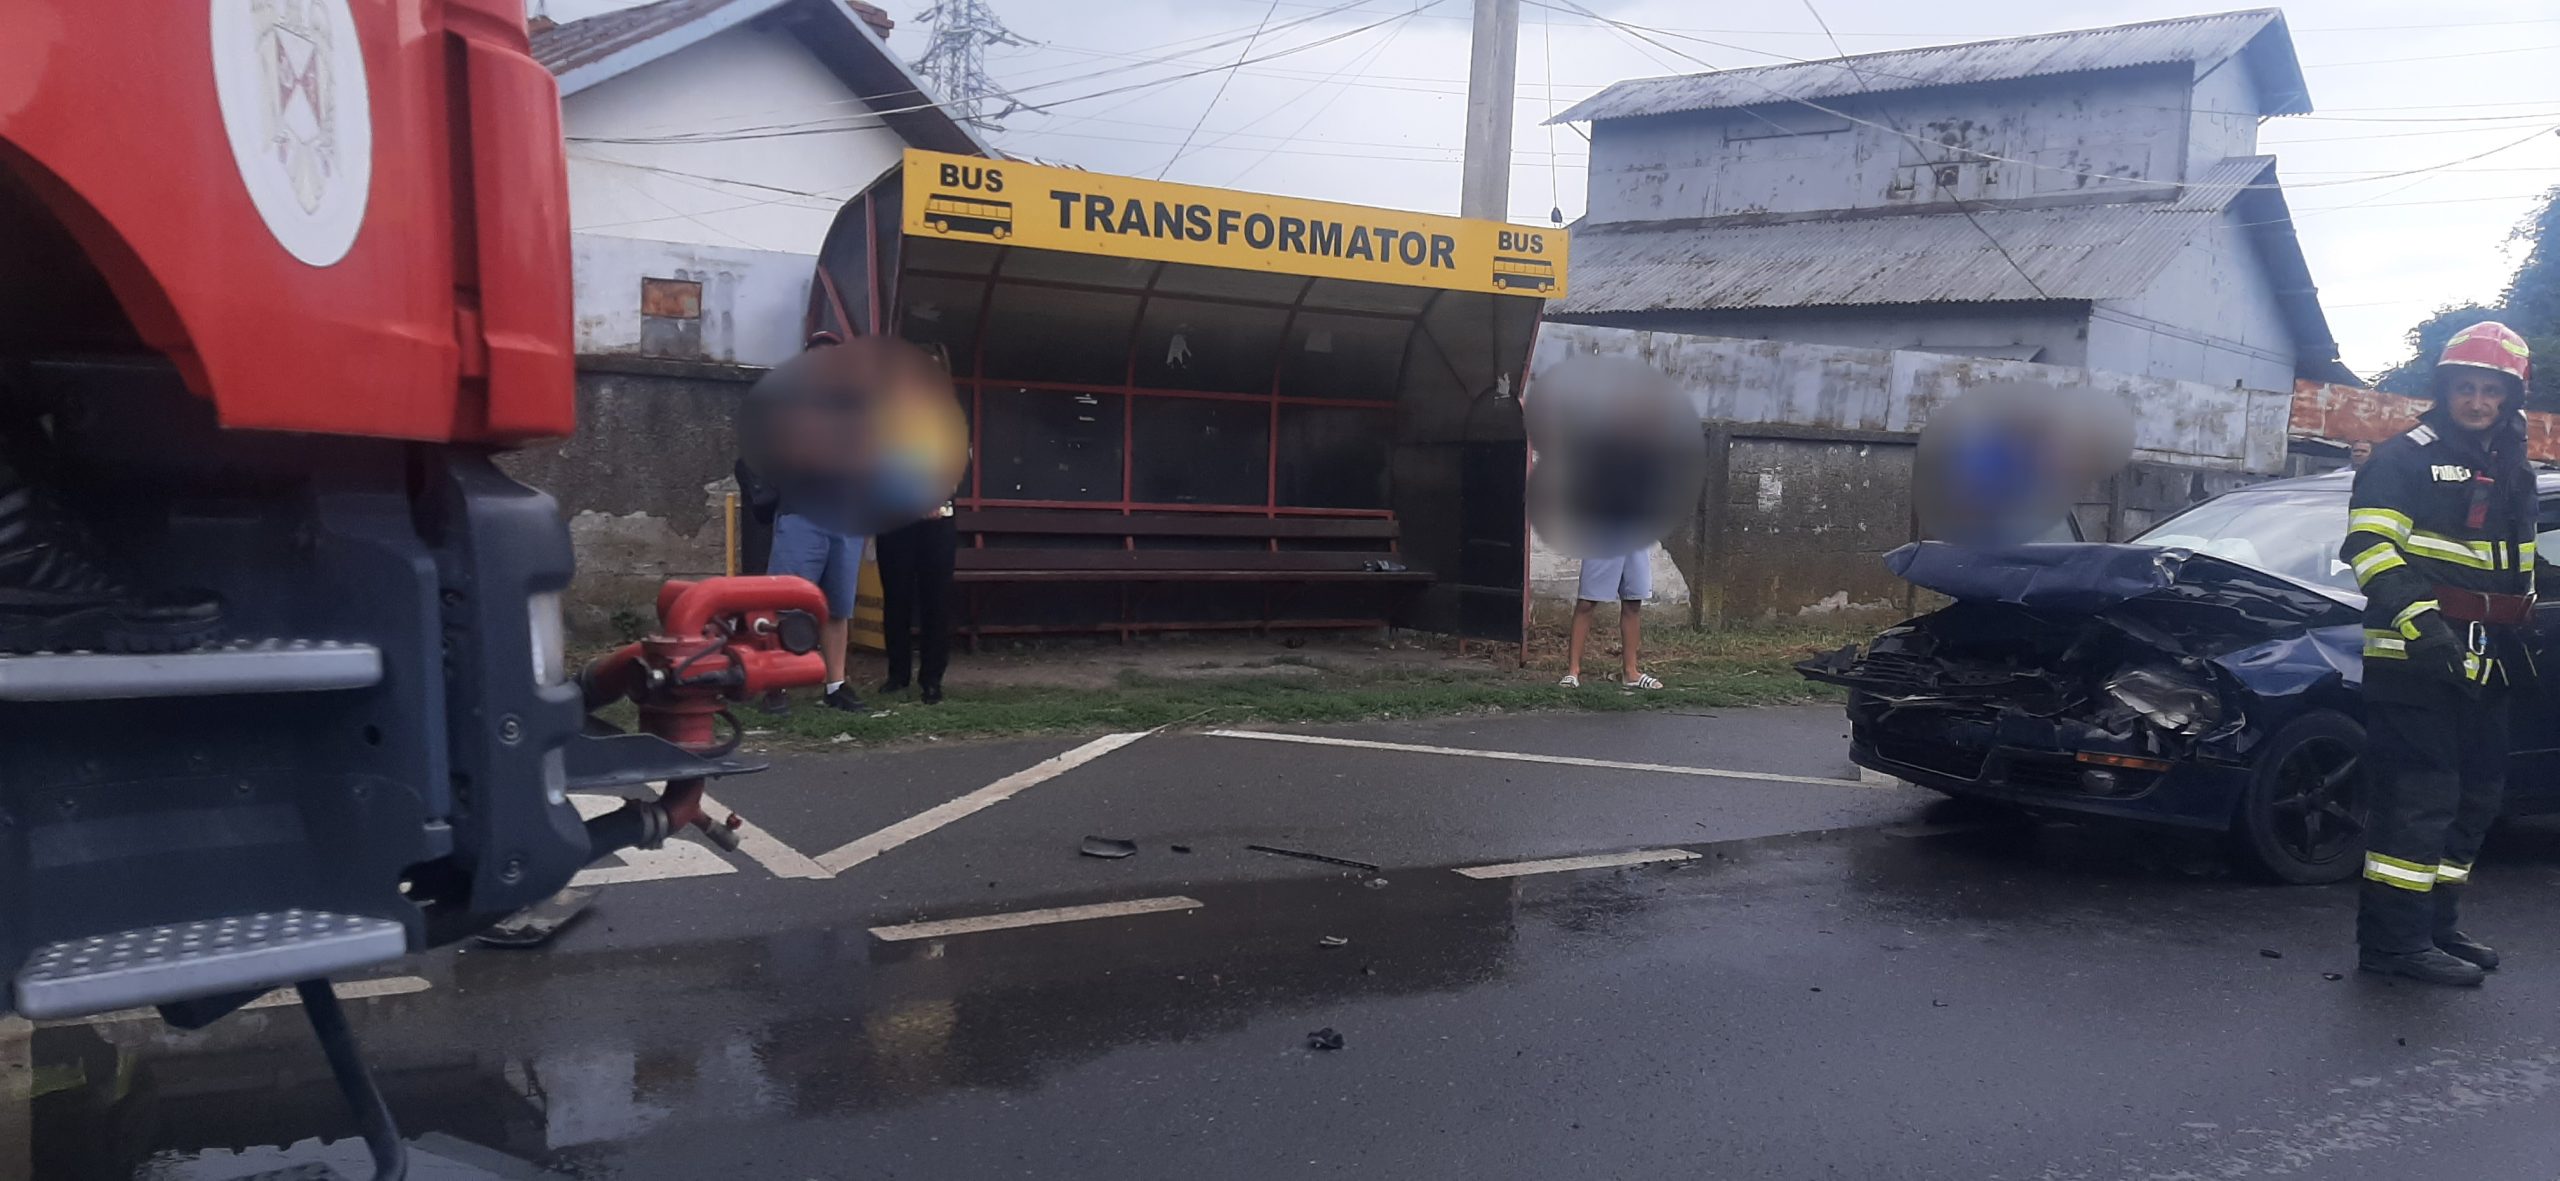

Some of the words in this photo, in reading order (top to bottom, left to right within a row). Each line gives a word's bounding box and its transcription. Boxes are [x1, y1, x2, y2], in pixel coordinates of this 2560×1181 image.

[940, 163, 1003, 193] BUS
[1049, 190, 1456, 269] TRANSFORMATOR
[1498, 230, 1543, 254] BUS
